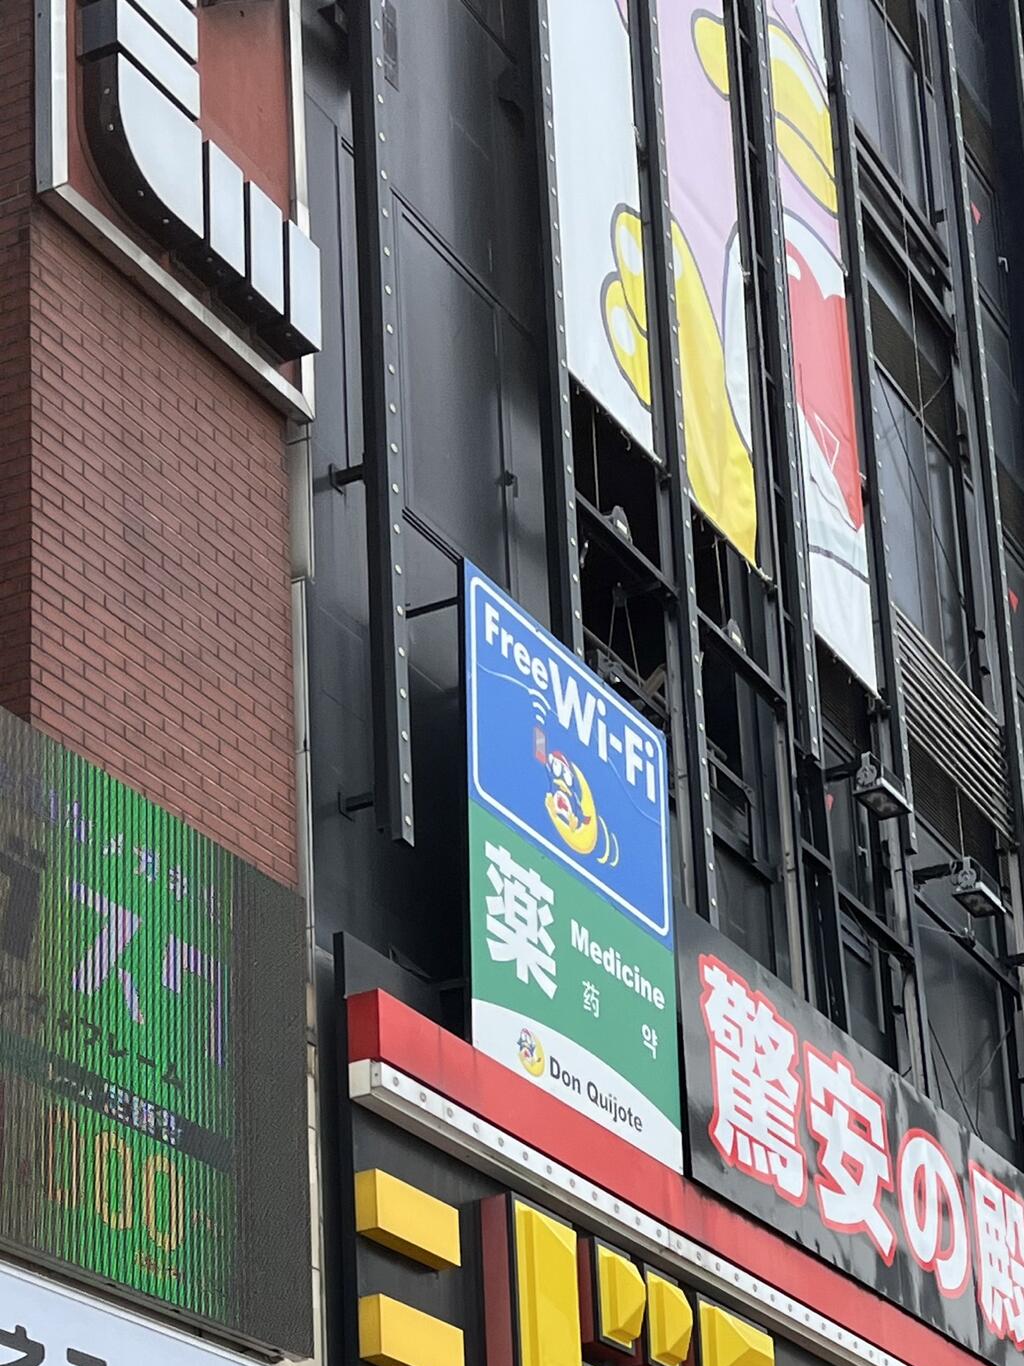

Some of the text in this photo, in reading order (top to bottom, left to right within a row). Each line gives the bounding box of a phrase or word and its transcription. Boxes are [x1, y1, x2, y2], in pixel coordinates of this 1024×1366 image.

[484, 602, 657, 803] Free Wi-Fi
[485, 839, 558, 1000] 薬
[570, 918, 666, 1010] Medicine
[641, 1024, 658, 1060] 약
[550, 1056, 643, 1133] Don Quijote
